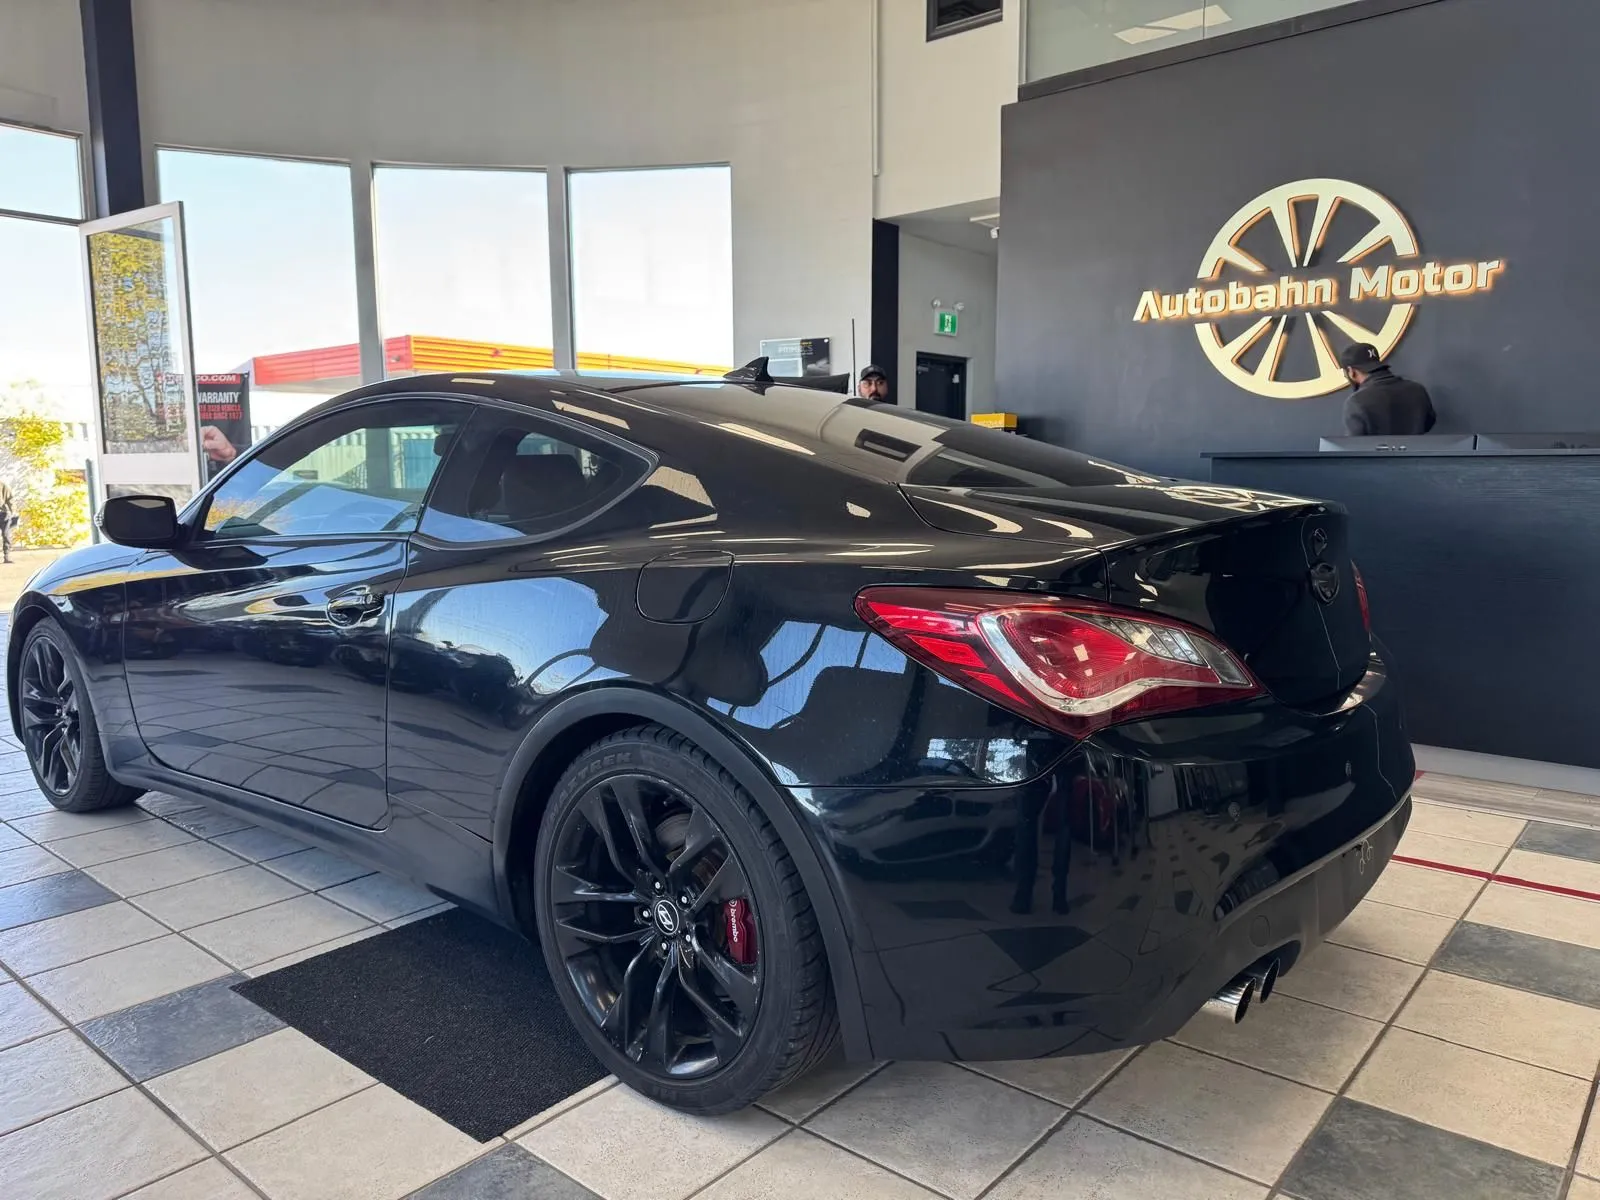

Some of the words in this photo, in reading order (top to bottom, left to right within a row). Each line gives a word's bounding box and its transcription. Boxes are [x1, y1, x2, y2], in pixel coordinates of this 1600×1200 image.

[1132, 275, 1334, 322] Autobahn
[1349, 259, 1501, 300] Motor
[730, 908, 739, 942] brembo
